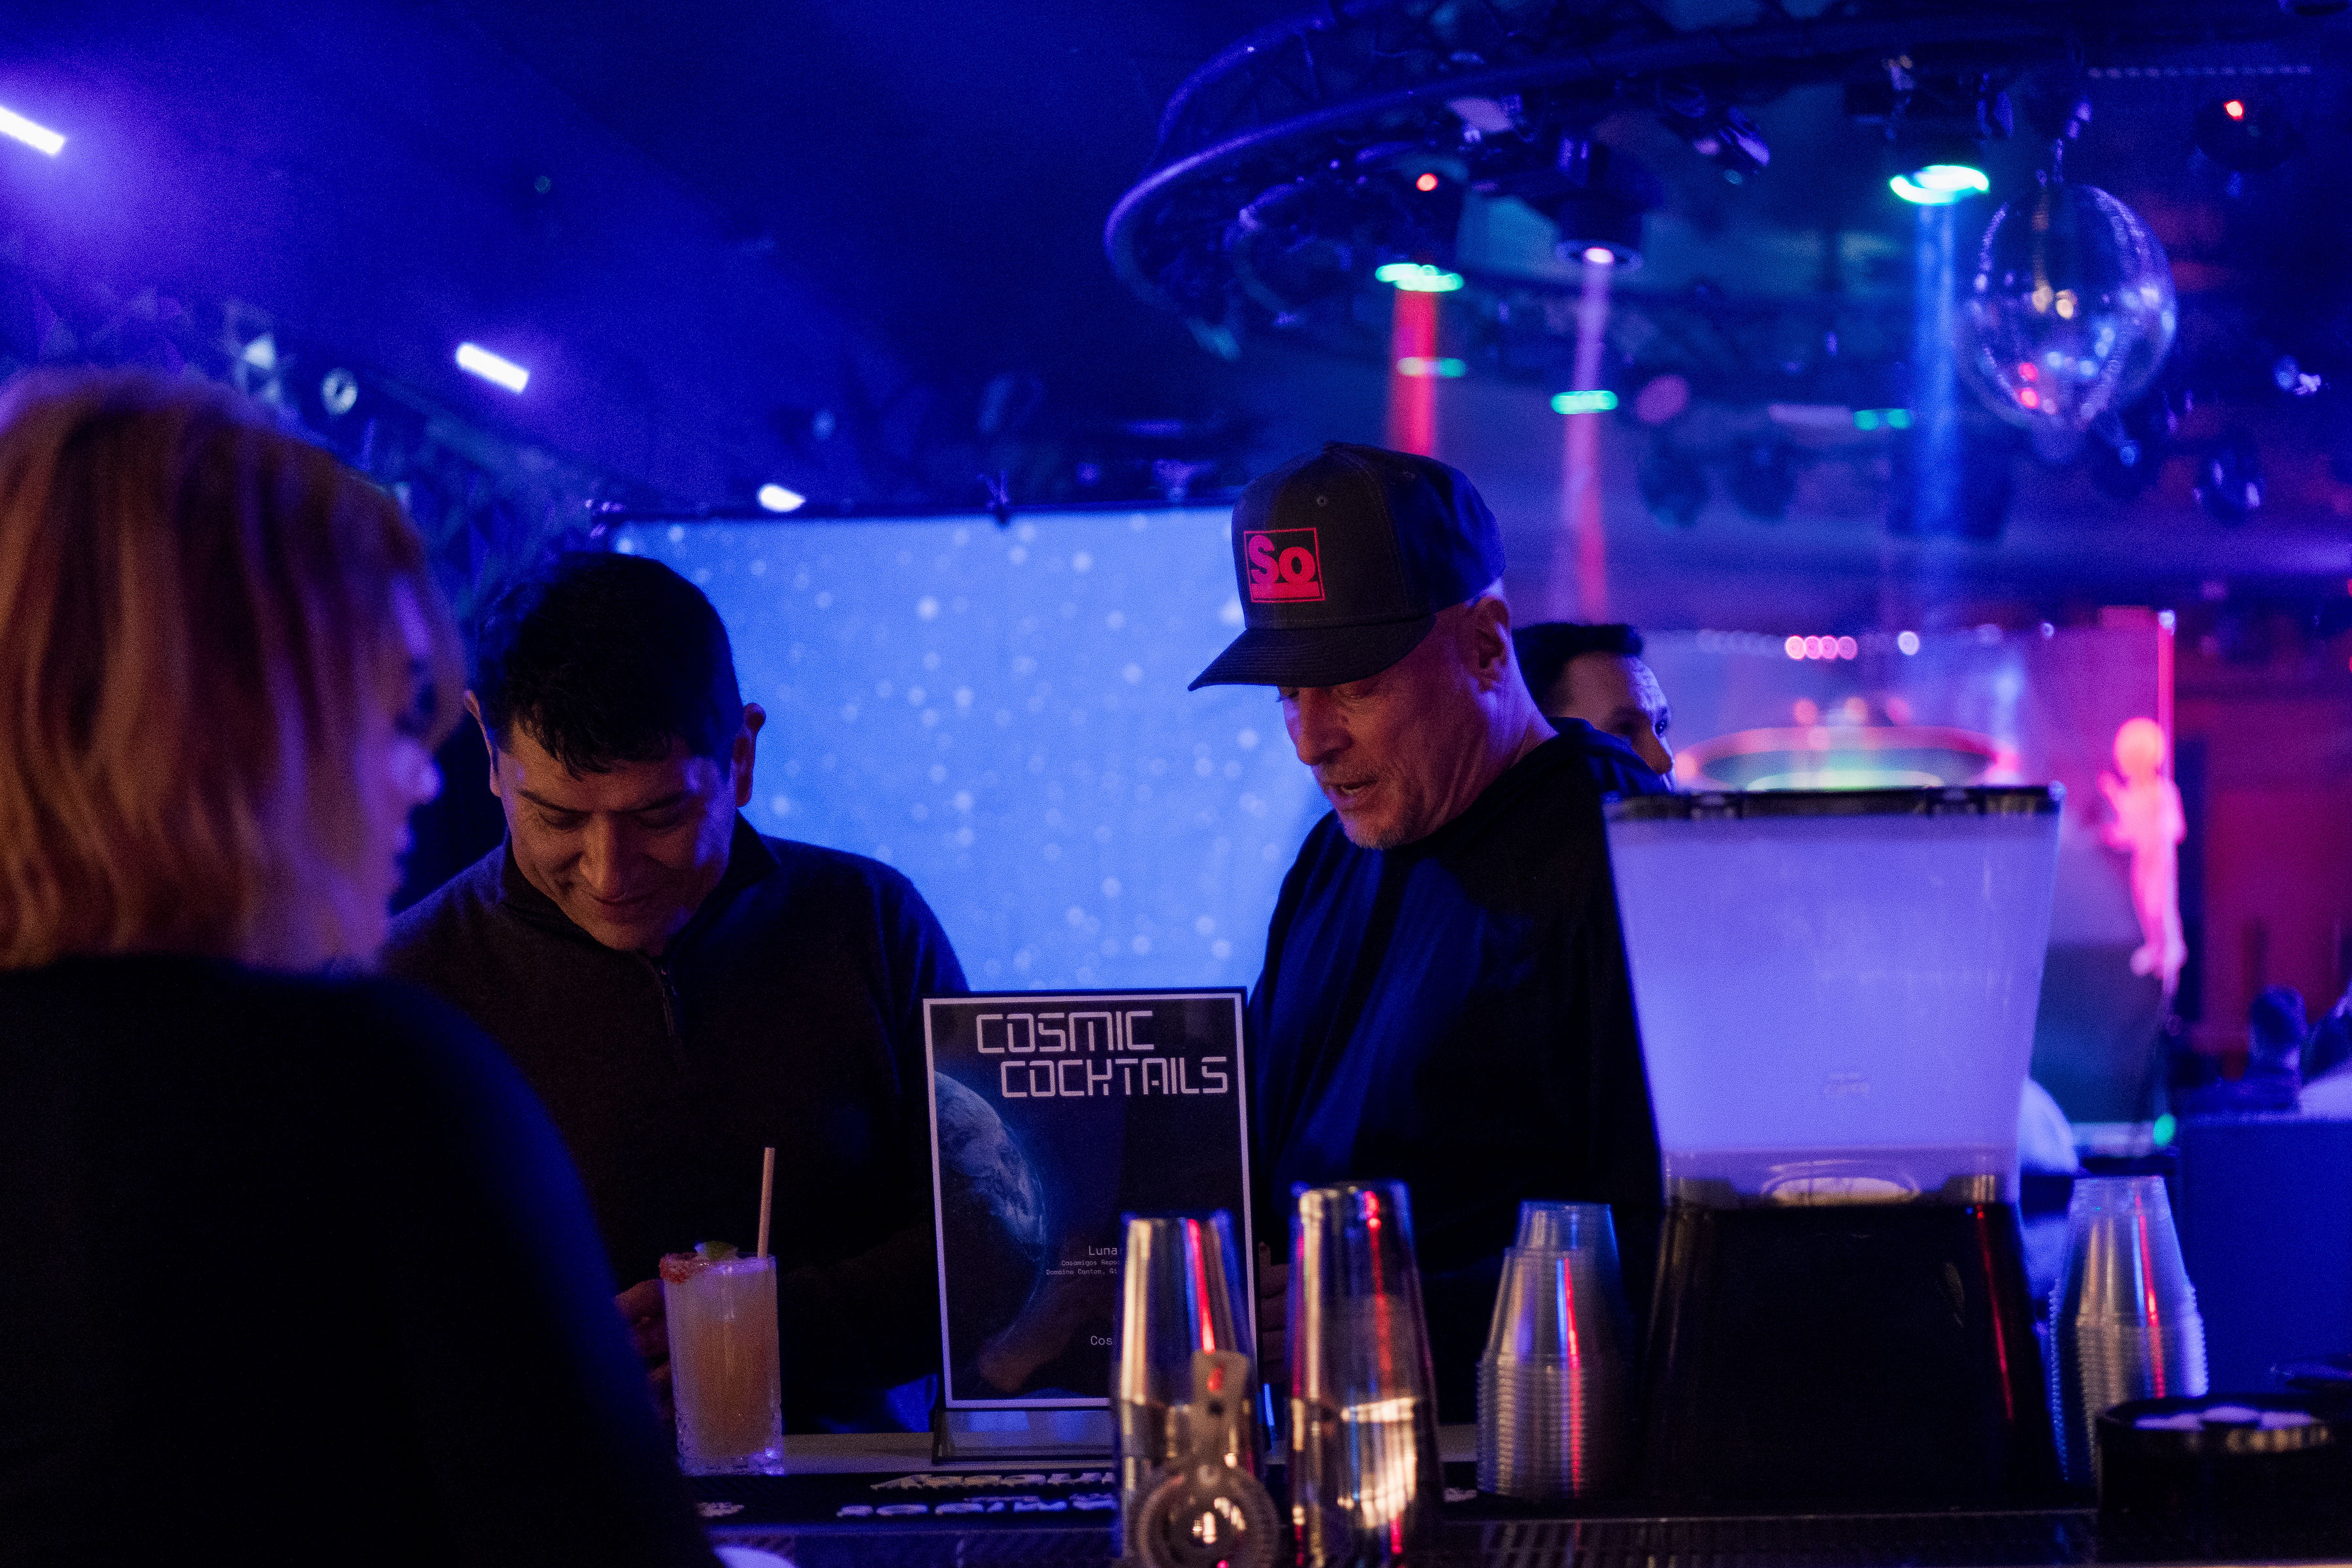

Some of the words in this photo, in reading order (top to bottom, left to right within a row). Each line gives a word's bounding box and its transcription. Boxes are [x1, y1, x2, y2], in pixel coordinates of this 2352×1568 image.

[1249, 535, 1316, 585] So
[976, 1011, 1154, 1053] COSMIC
[1000, 1056, 1228, 1098] COCKTAILS
[1088, 1245, 1119, 1256] Luna
[1090, 1335, 1113, 1346] Cos
